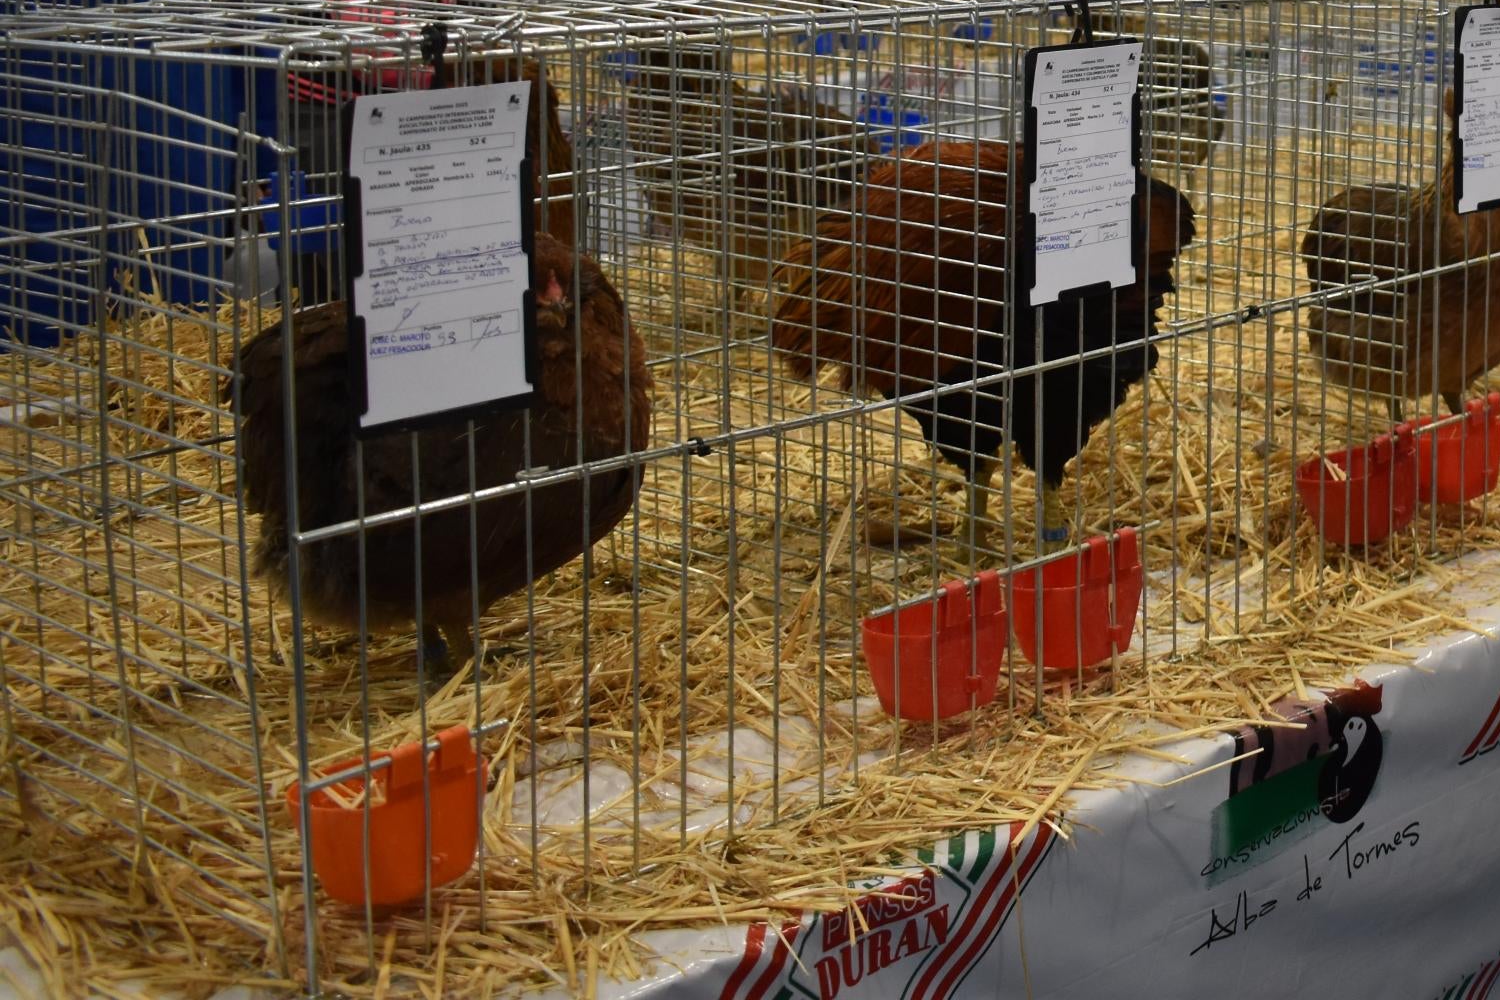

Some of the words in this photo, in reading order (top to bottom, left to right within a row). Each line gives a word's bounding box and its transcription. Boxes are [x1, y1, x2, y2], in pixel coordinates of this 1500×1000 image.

[405, 113, 444, 122] CAMPEONATO
[445, 109, 487, 118] INTERNACIONAL
[399, 127, 437, 136] CAMPEONATO
[447, 123, 472, 131] CASTILLA
[416, 143, 431, 151] 435
[399, 332, 431, 342] MAROTO
[1190, 890, 1278, 956] Alba
[1297, 854, 1322, 901] de
[1329, 822, 1420, 879] Tormes
[827, 876, 933, 946] PIENSOS
[814, 904, 950, 1000] DURAN
